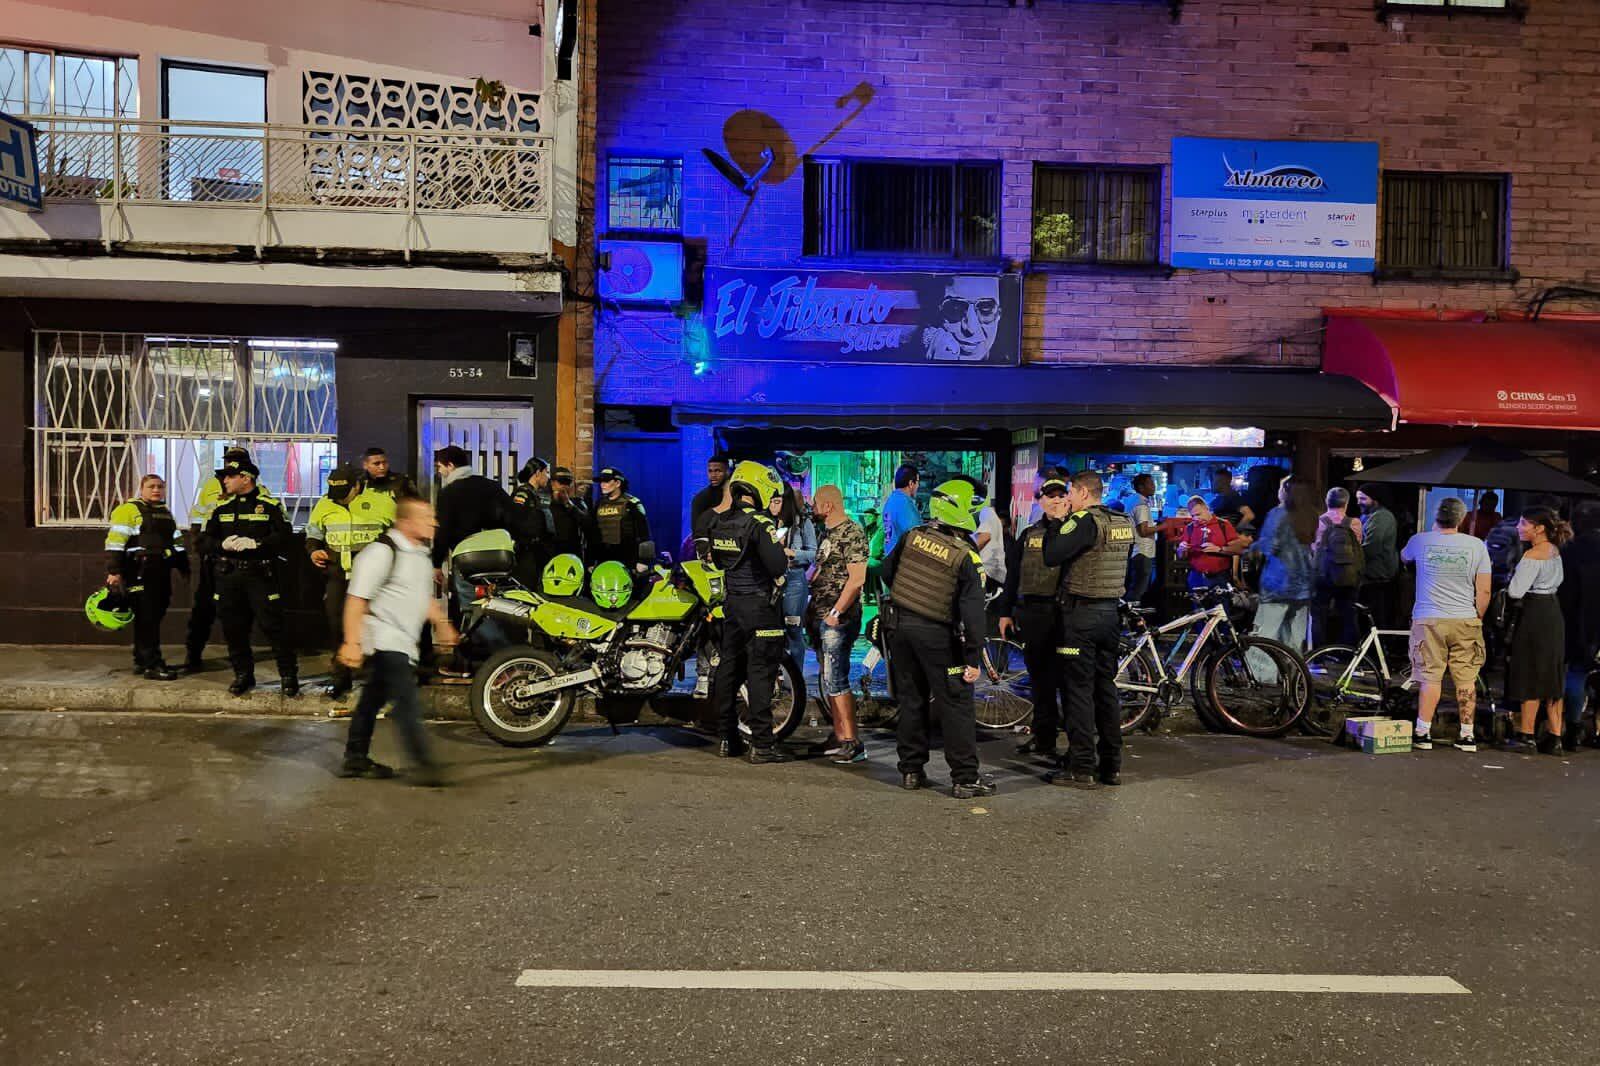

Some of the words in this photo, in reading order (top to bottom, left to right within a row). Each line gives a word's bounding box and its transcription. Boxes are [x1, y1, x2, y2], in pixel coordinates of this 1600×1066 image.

[0, 181, 38, 202] OTEL
[1328, 212, 1356, 222] starvit
[715, 279, 757, 337] El
[758, 275, 898, 338] Jibarito
[449, 367, 483, 378] 53-34
[1510, 391, 1545, 401] CHIVAS
[1111, 528, 1133, 540] POLICIA
[912, 534, 950, 560] POLICIA
